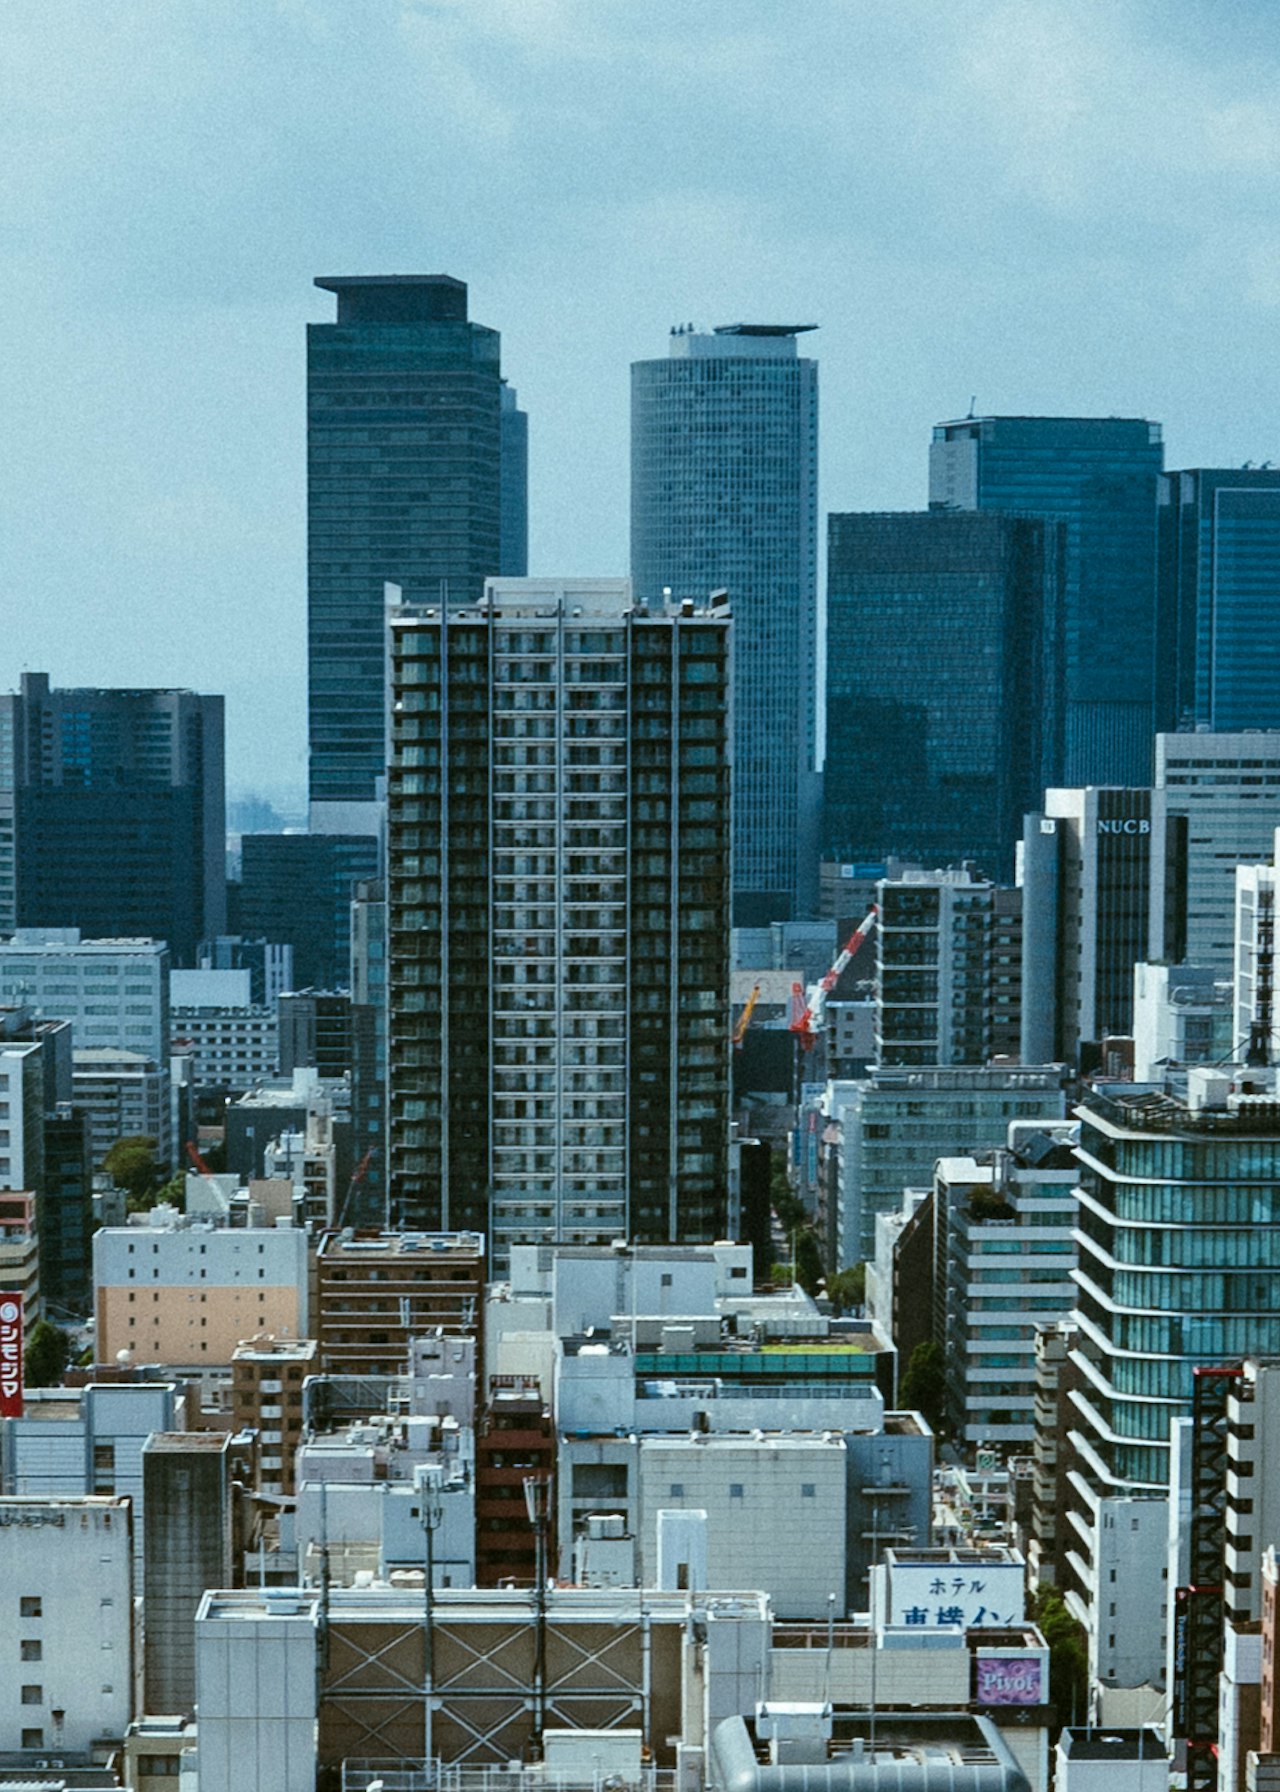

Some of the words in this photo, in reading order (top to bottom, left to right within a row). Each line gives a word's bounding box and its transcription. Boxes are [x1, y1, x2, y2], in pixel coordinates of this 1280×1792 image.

[1098, 819, 1150, 834] NUCB
[0, 1324, 19, 1399] シモジマ
[928, 1577, 987, 1597] ホテル
[983, 1672, 1034, 1692] Pivot
